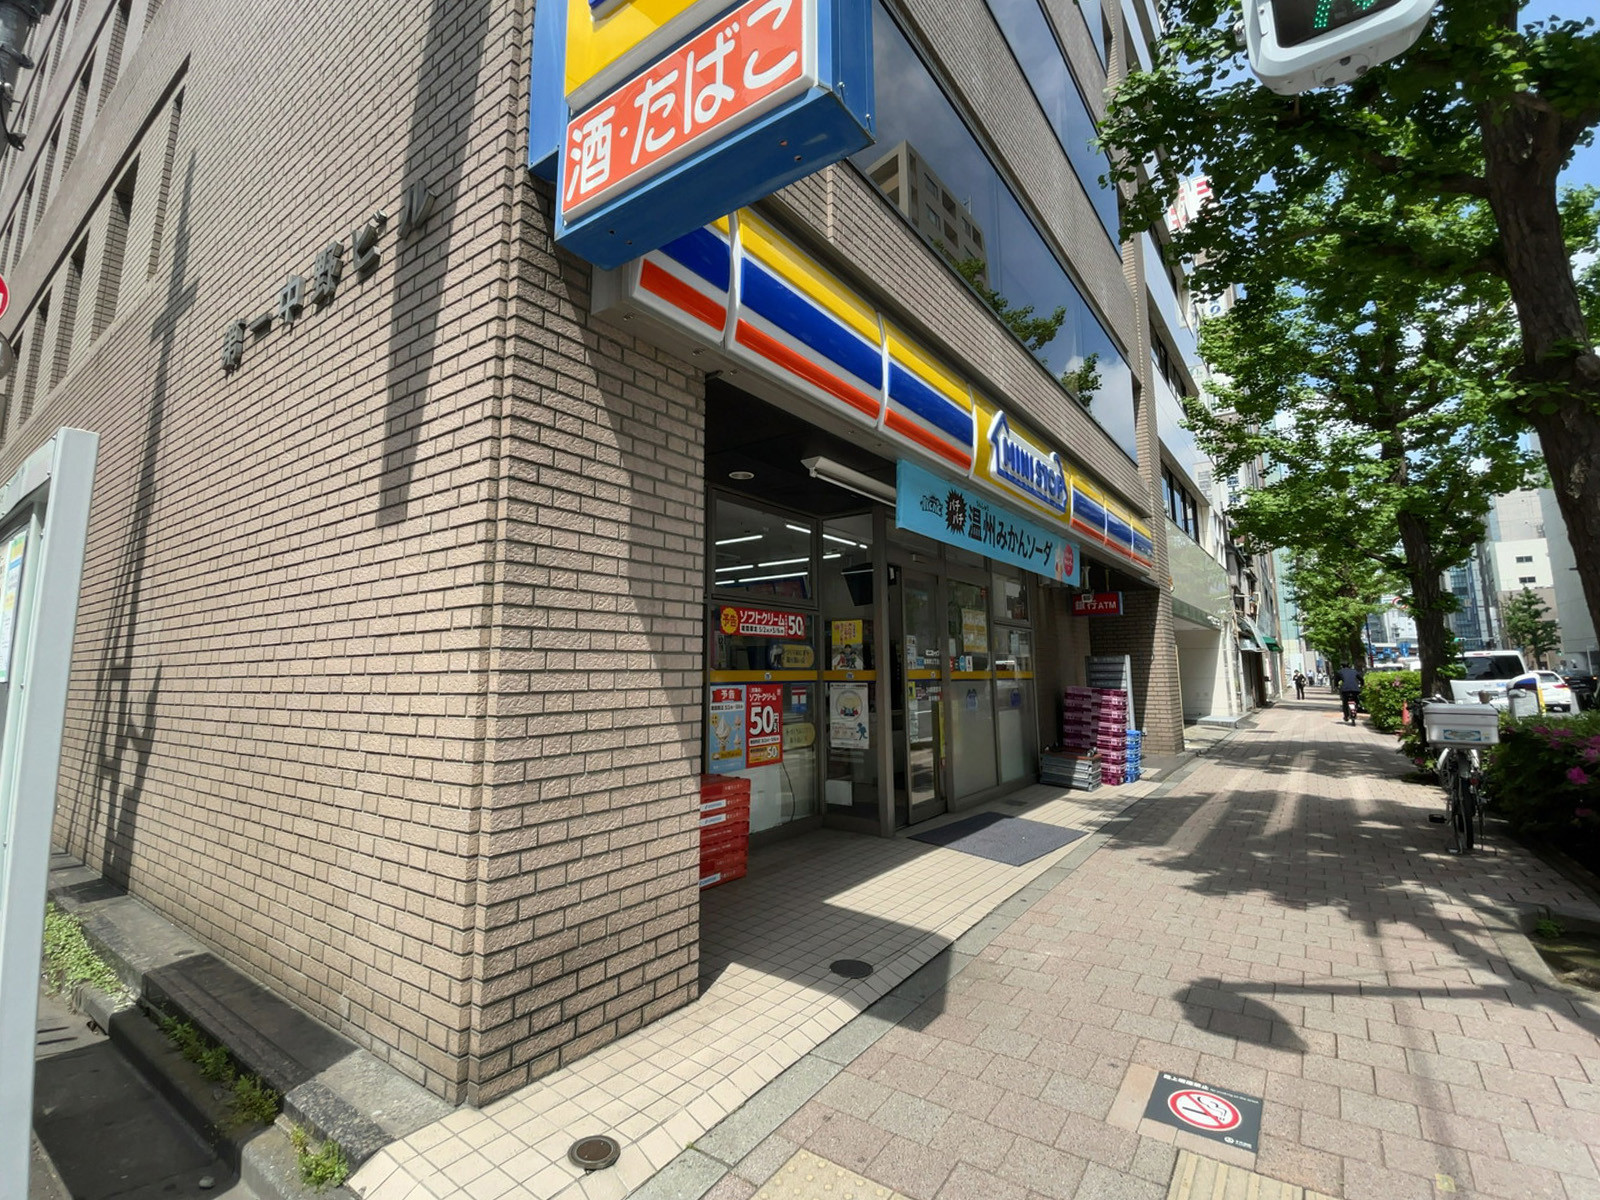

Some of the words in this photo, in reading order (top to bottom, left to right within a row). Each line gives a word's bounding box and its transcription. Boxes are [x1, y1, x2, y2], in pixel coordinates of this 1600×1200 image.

[566, 0, 798, 202] 酒・たばこ
[1002, 435, 1034, 484] MINI
[1035, 458, 1065, 502] STOP
[968, 505, 1053, 568] 温州みかんソーダ
[722, 613, 736, 627] 予告
[740, 610, 784, 626] ソフトクリーム
[788, 615, 804, 636] 50
[721, 689, 735, 700] 予告
[749, 693, 777, 702] ソフトクリーム
